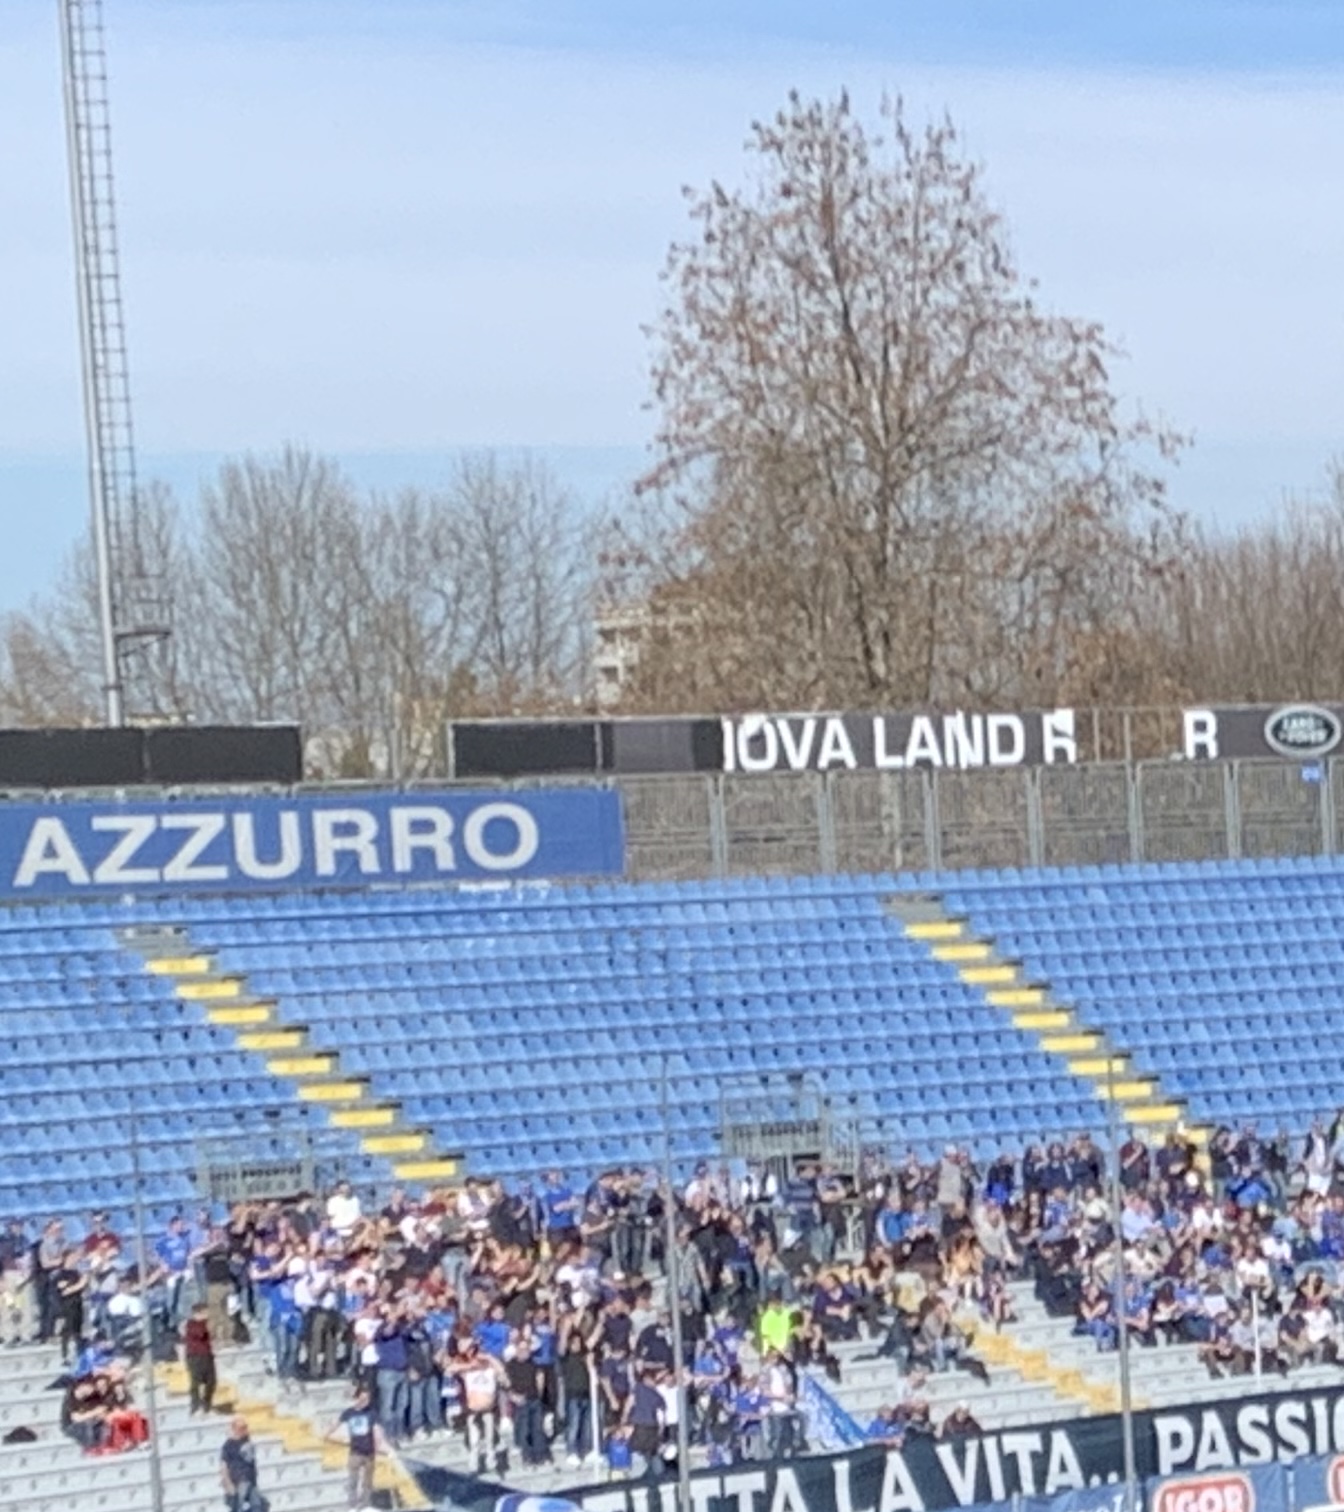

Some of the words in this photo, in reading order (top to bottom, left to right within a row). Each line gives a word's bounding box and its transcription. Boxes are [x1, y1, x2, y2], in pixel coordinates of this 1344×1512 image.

[873, 708, 1026, 770] LAND
[1184, 709, 1218, 760] R
[13, 802, 540, 887] AZZURRO
